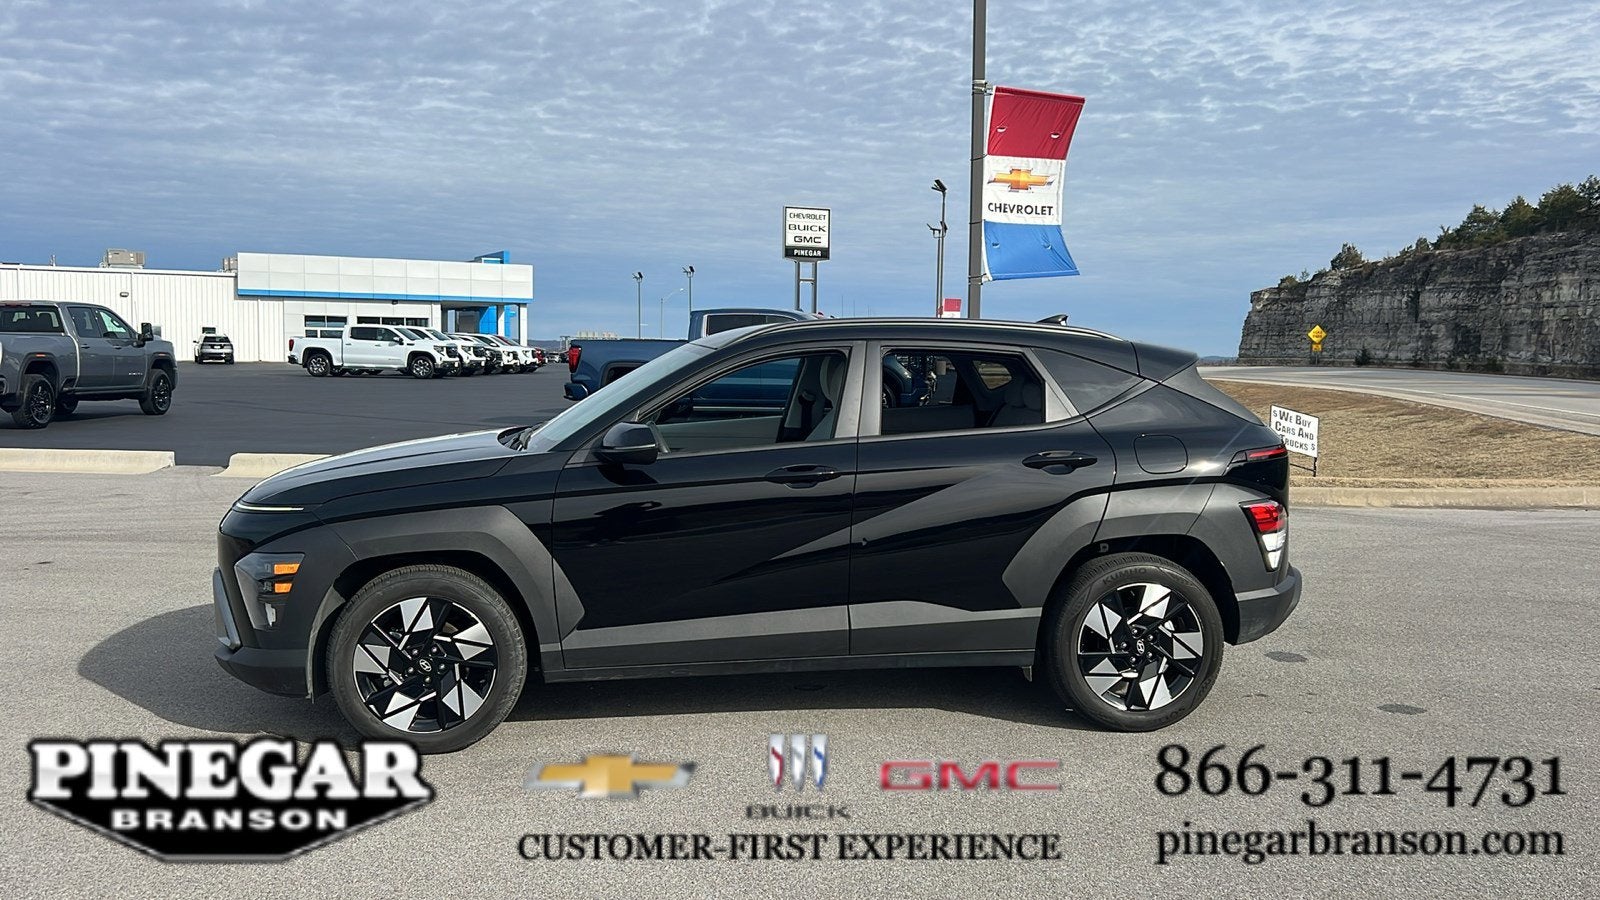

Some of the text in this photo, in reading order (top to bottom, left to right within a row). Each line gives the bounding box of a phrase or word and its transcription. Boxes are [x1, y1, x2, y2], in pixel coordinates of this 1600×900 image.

[988, 202, 1053, 216] CHEVROLET
[789, 212, 826, 220] CHEVROLET
[788, 223, 826, 232] BUICK
[793, 235, 821, 244] GMC
[793, 249, 822, 257] PINEGAR
[1102, 567, 1147, 585] KUMHO
